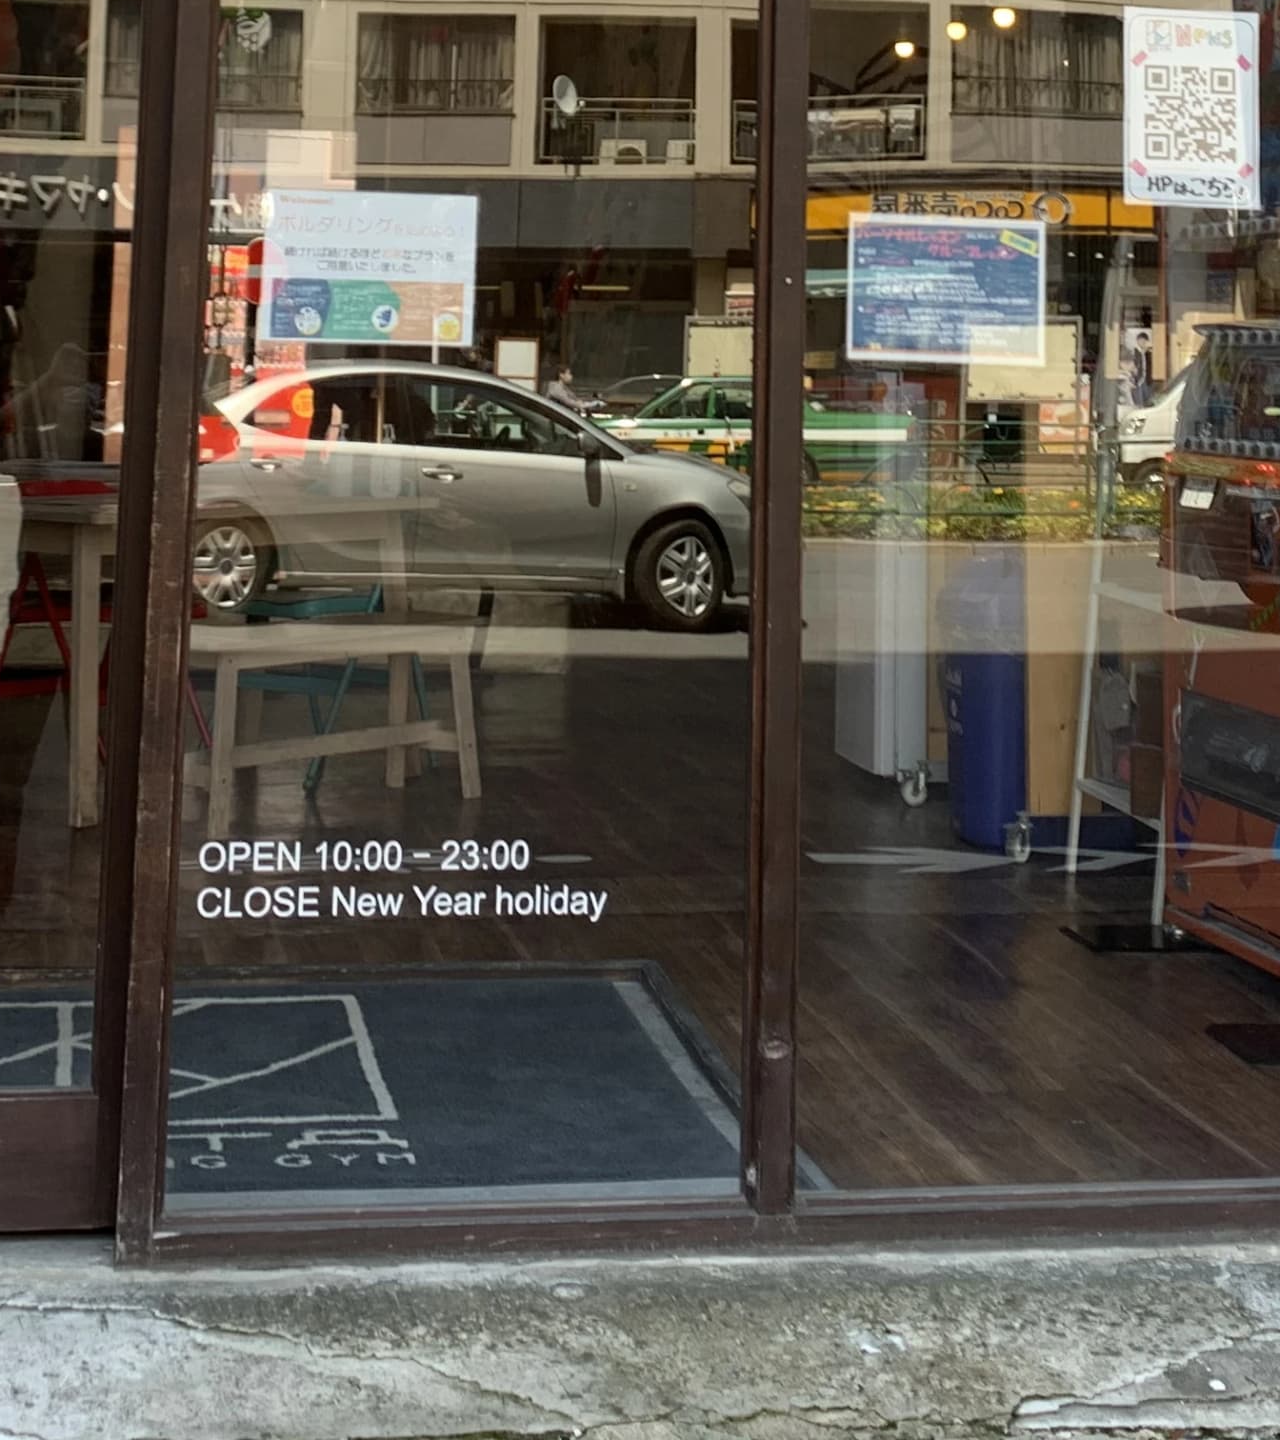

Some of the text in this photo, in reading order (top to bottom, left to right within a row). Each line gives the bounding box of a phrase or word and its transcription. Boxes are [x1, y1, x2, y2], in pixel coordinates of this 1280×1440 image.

[198, 841, 301, 873] OPEN
[316, 840, 403, 872] 10:00
[441, 839, 530, 872] 23:00
[197, 884, 608, 922] CLOSE New Year holiday
